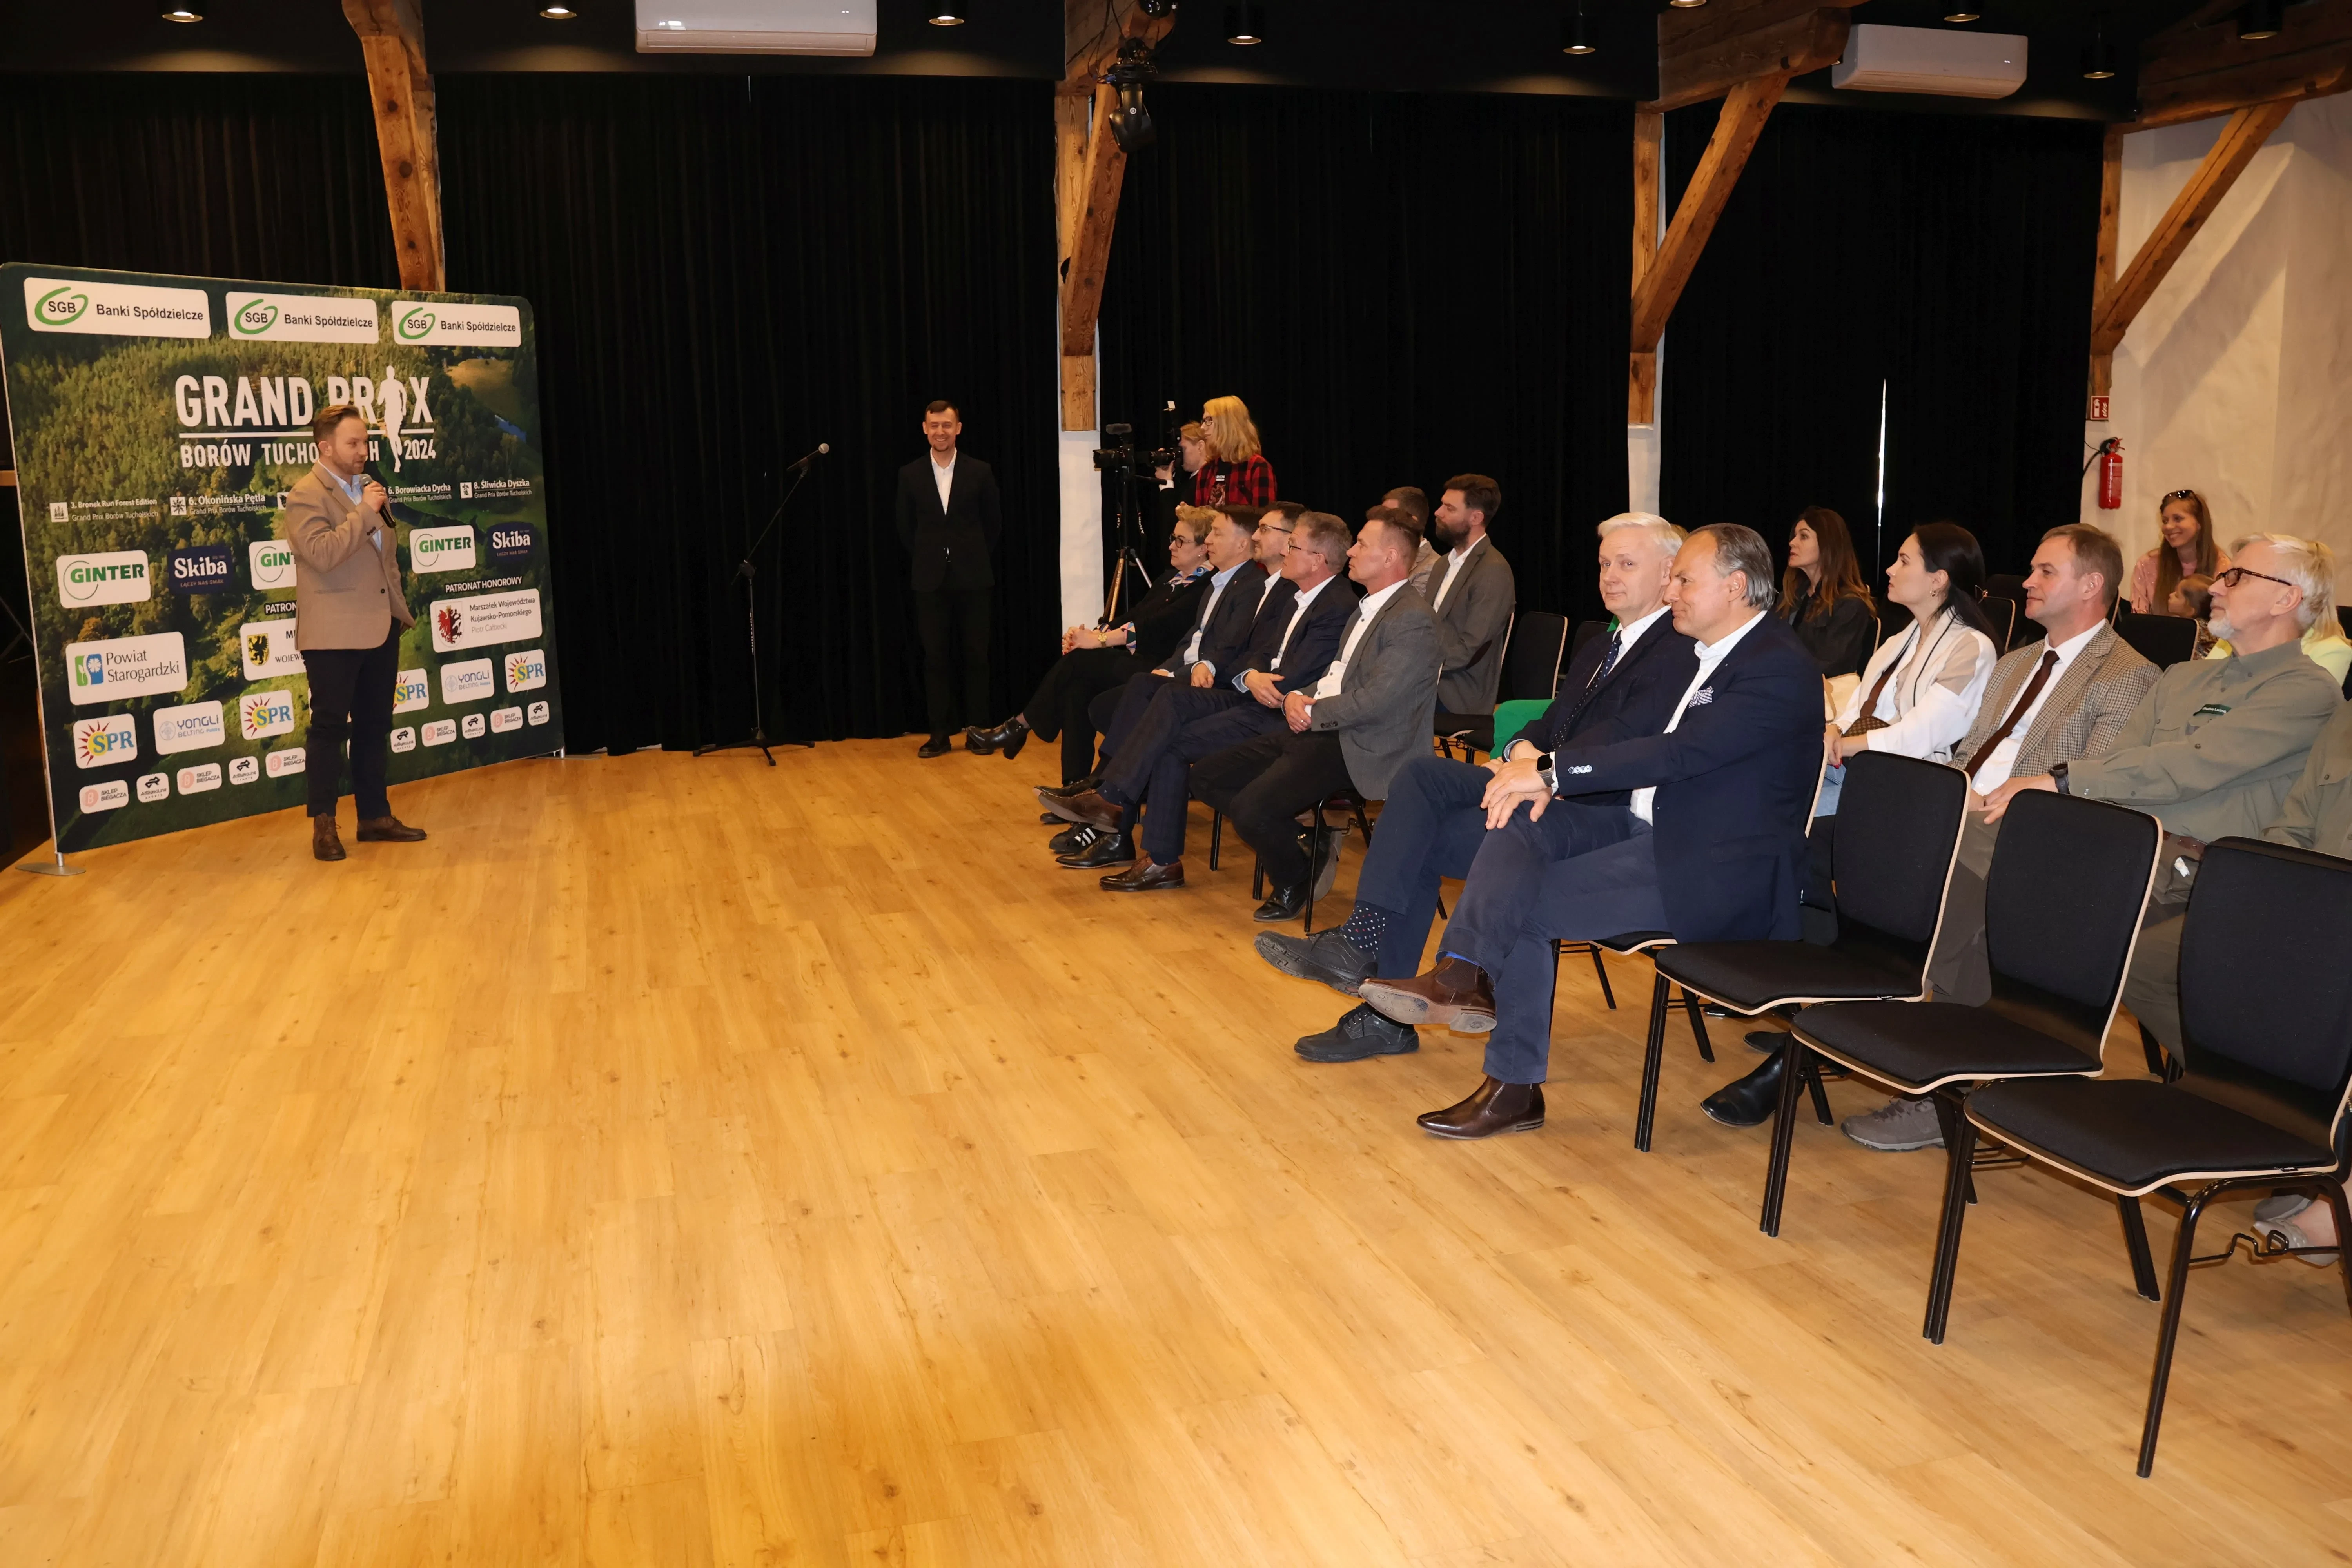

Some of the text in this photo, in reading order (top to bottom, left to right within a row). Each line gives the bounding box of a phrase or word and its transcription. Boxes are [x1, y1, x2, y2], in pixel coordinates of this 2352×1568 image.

[48, 301, 76, 313] SGB
[96, 304, 203, 320] Banki Spółdzielcze
[245, 312, 268, 323] SGB
[285, 314, 373, 328] Banki Spółdzielcze
[408, 319, 427, 329] SGB
[441, 321, 516, 332] Banki Spółdzielcze
[175, 375, 313, 427] GRAND
[180, 438, 251, 468] BORÓW
[404, 439, 436, 460] 2024
[395, 485, 431, 494] Borowiacka
[432, 483, 452, 493] Dycha
[474, 479, 530, 490] 8. Śliwicka Dyszka
[188, 493, 266, 505] 6. Okonińska Pętla
[419, 537, 471, 553] GINTER
[492, 530, 531, 549] Skiba
[174, 555, 227, 579] Skiba
[261, 552, 293, 567] GIN
[71, 564, 144, 584] GINTER
[445, 576, 522, 593] PATRONAT HONOROWY
[265, 602, 297, 614] PATRON
[470, 597, 535, 611] Marszałek Województwa
[471, 608, 532, 622] Kujawsko-Pomorskiego
[106, 650, 147, 665] Powiat
[108, 661, 179, 682] Starogardzki
[517, 663, 544, 681] SPR
[396, 683, 427, 702] SPR
[256, 705, 292, 726] SPR
[93, 731, 134, 753] SPR
[196, 775, 220, 784] BIEGACZA
[101, 792, 127, 801] BIEGACZA
